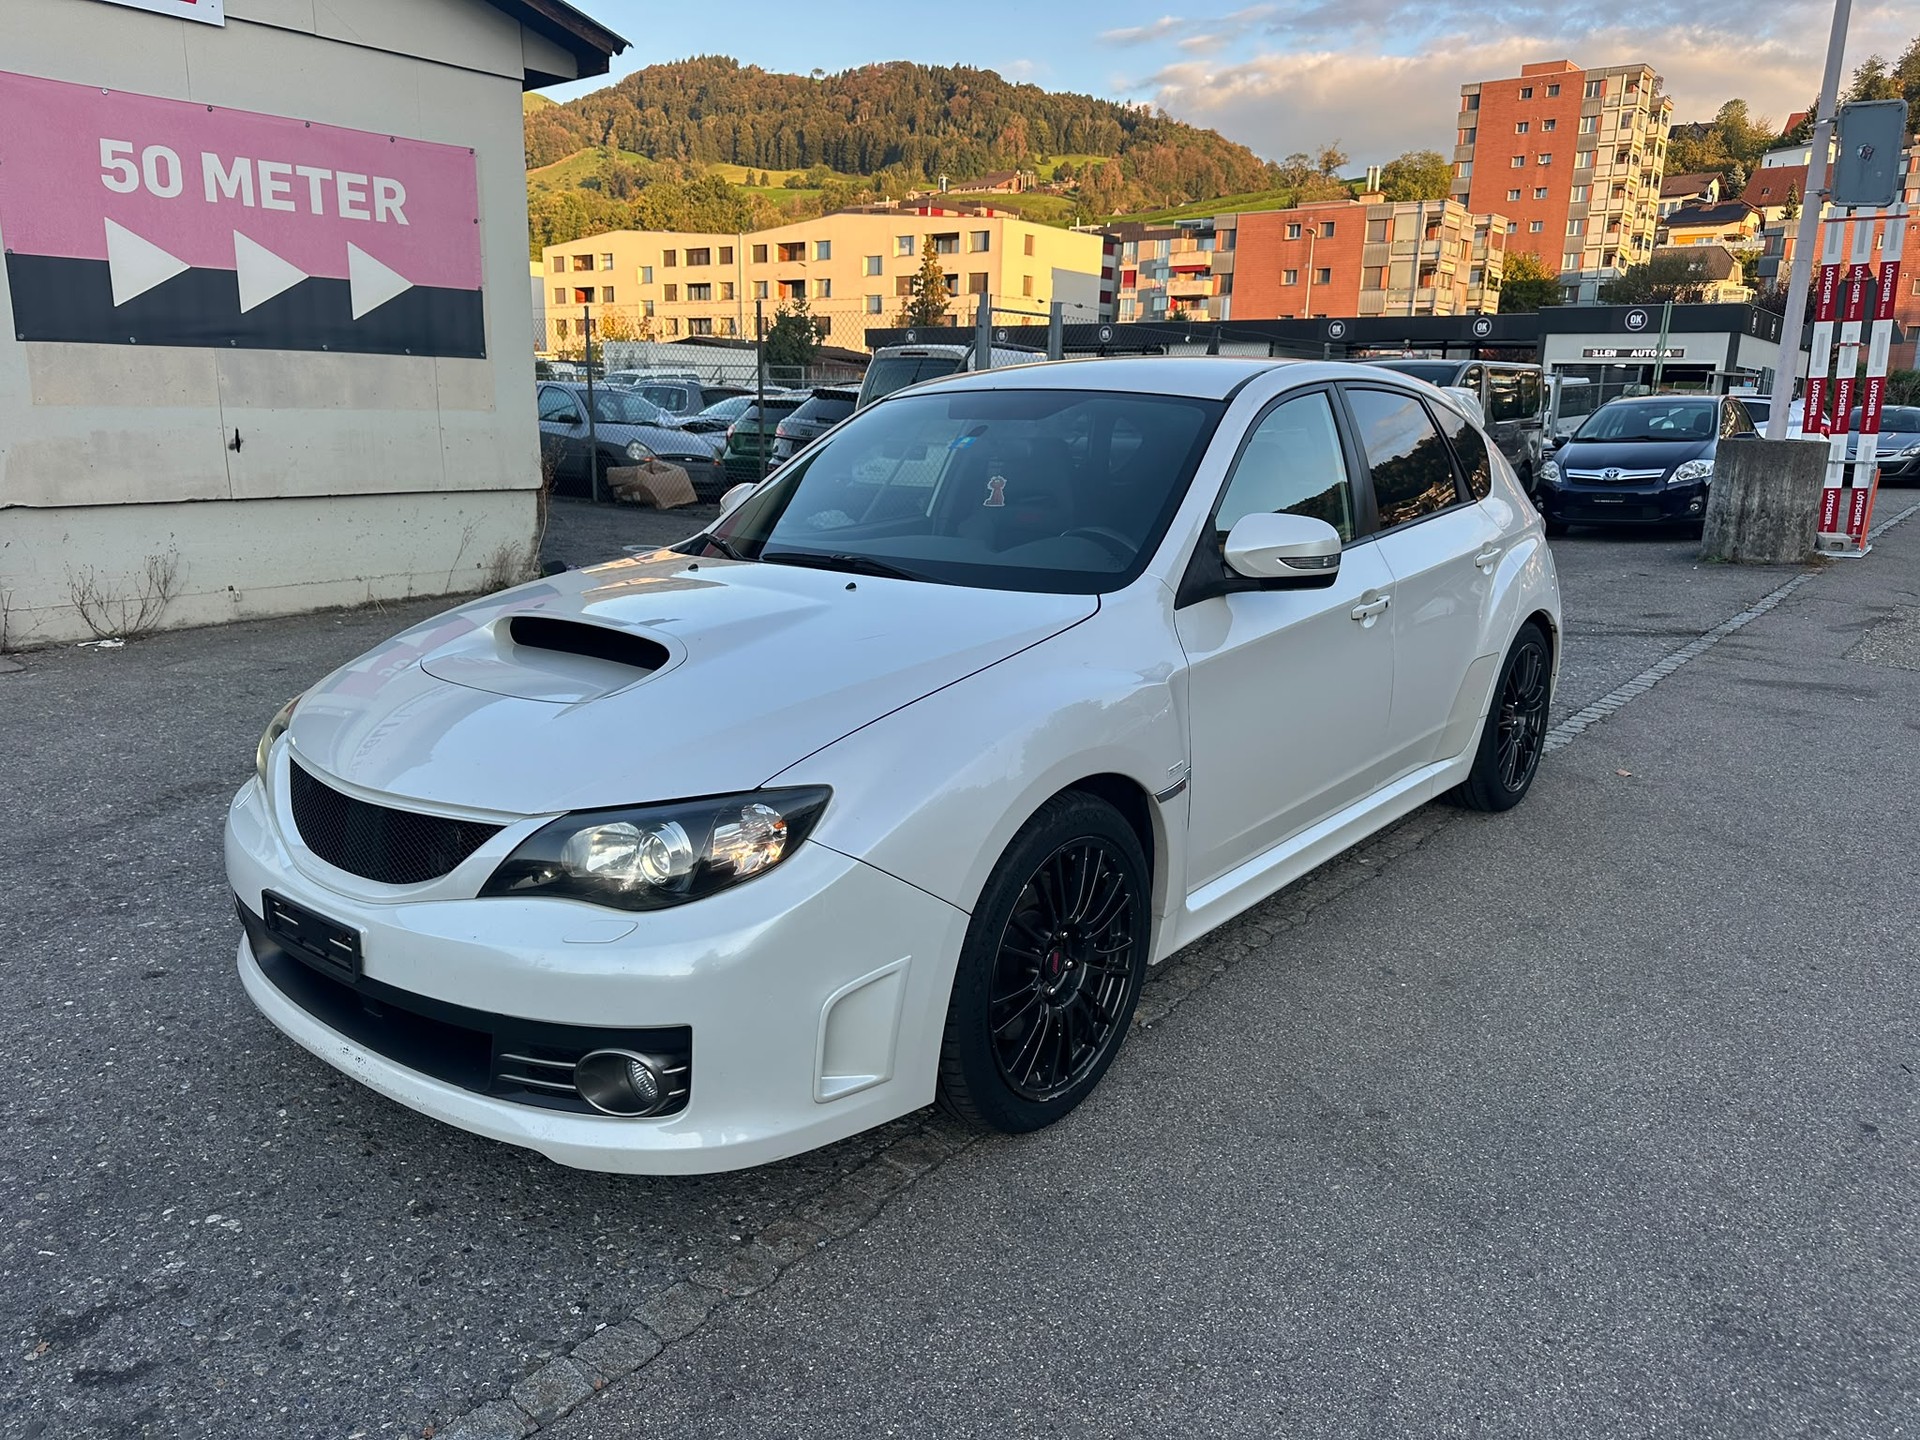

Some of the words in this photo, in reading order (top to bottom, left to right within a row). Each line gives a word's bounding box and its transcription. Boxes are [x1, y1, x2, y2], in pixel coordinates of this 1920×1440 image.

[100, 138, 183, 198] 50
[201, 152, 410, 225] METER
[1477, 322, 1488, 330] OK
[1630, 314, 1643, 324] OK
[1809, 380, 1821, 416] LÖTSCHER
[1838, 380, 1849, 417] LÖTSCHER
[1868, 380, 1879, 417] LÖTSCHER
[1824, 490, 1835, 525] LÖTSCHER
[1853, 491, 1865, 526] LÖTSCHER
